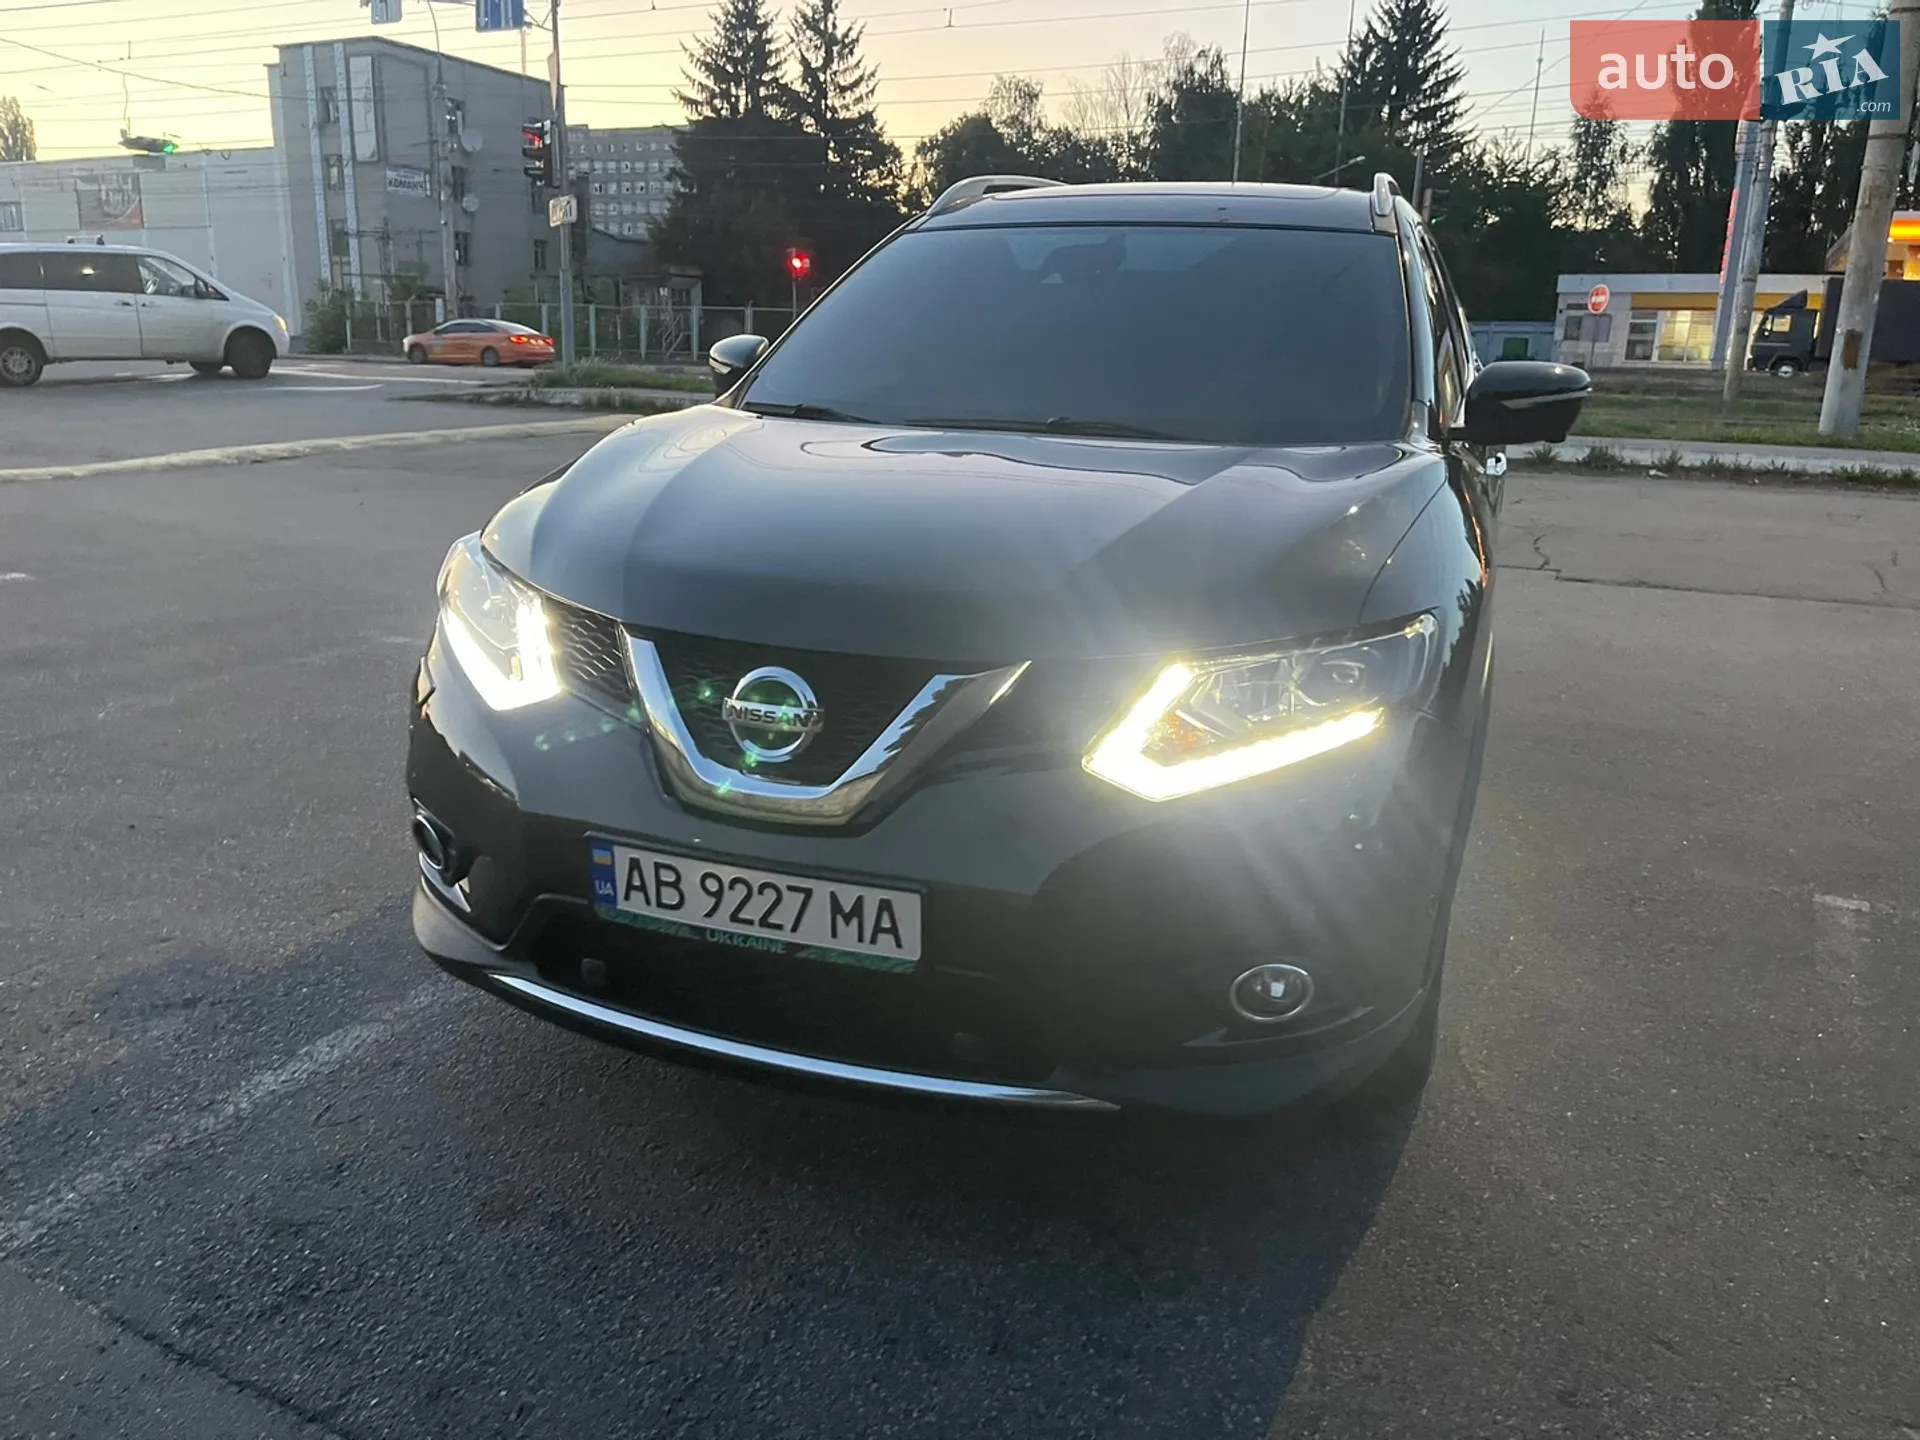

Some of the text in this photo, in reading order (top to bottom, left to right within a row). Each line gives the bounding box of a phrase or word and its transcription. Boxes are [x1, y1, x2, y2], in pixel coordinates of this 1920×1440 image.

[730, 705, 809, 727] NISSAN
[594, 880, 615, 896] UA
[623, 856, 904, 949] AB 9227 MA
